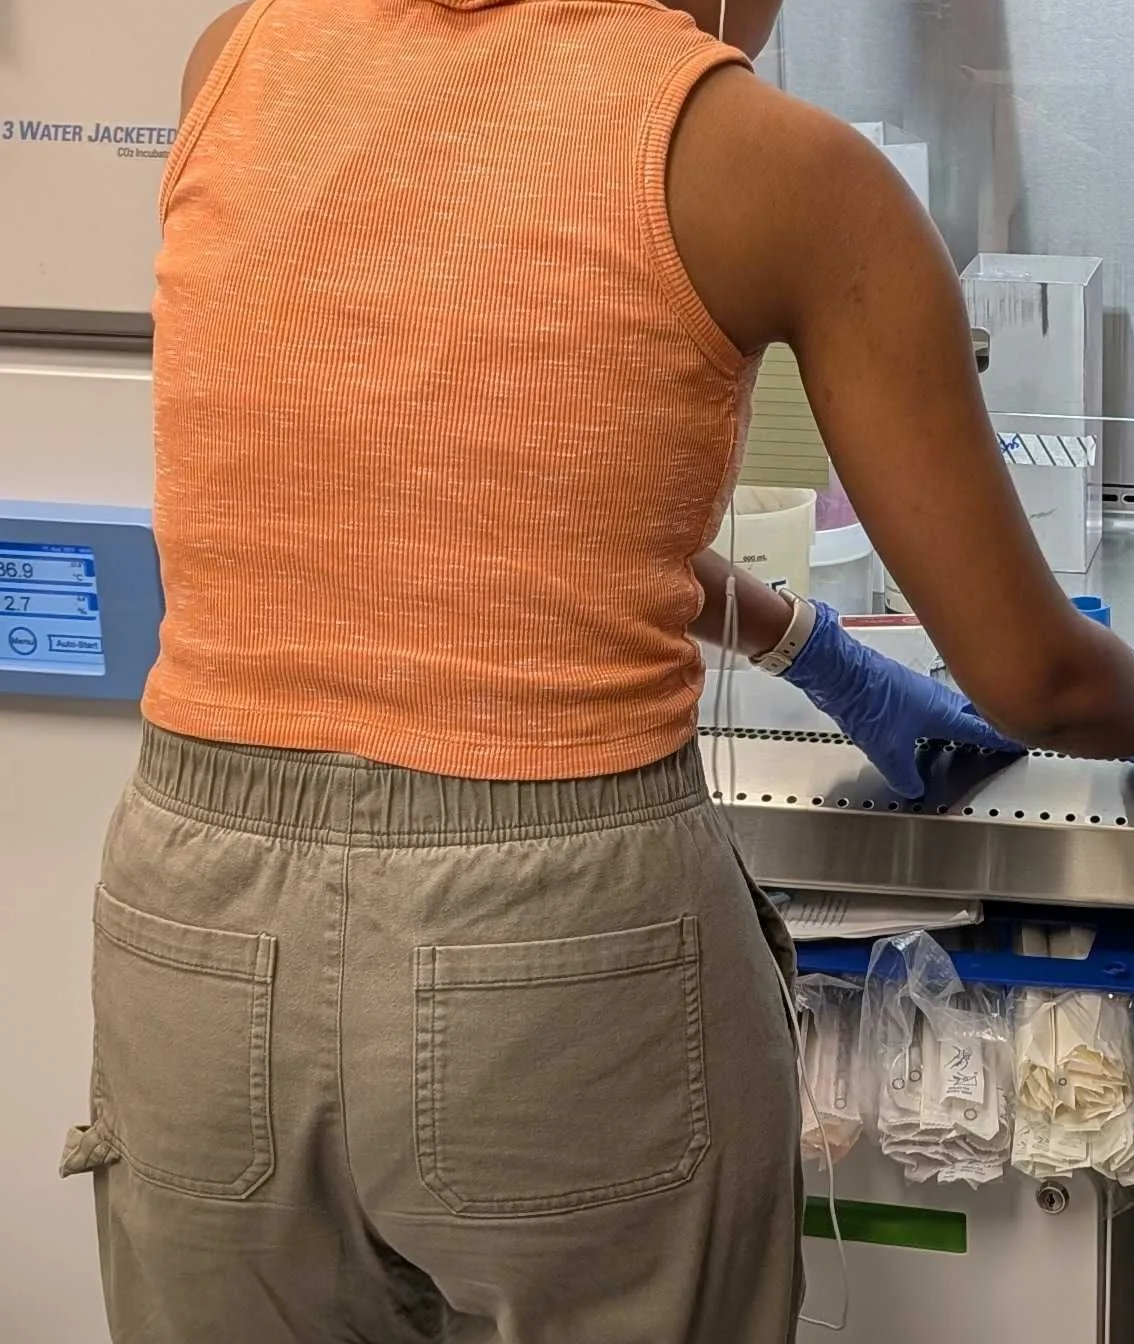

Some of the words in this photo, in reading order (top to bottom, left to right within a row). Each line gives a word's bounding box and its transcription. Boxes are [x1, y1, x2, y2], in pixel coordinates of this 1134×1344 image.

[2, 121, 14, 140] 3
[19, 121, 83, 142] WATER
[4, 596, 30, 611] 2.7
